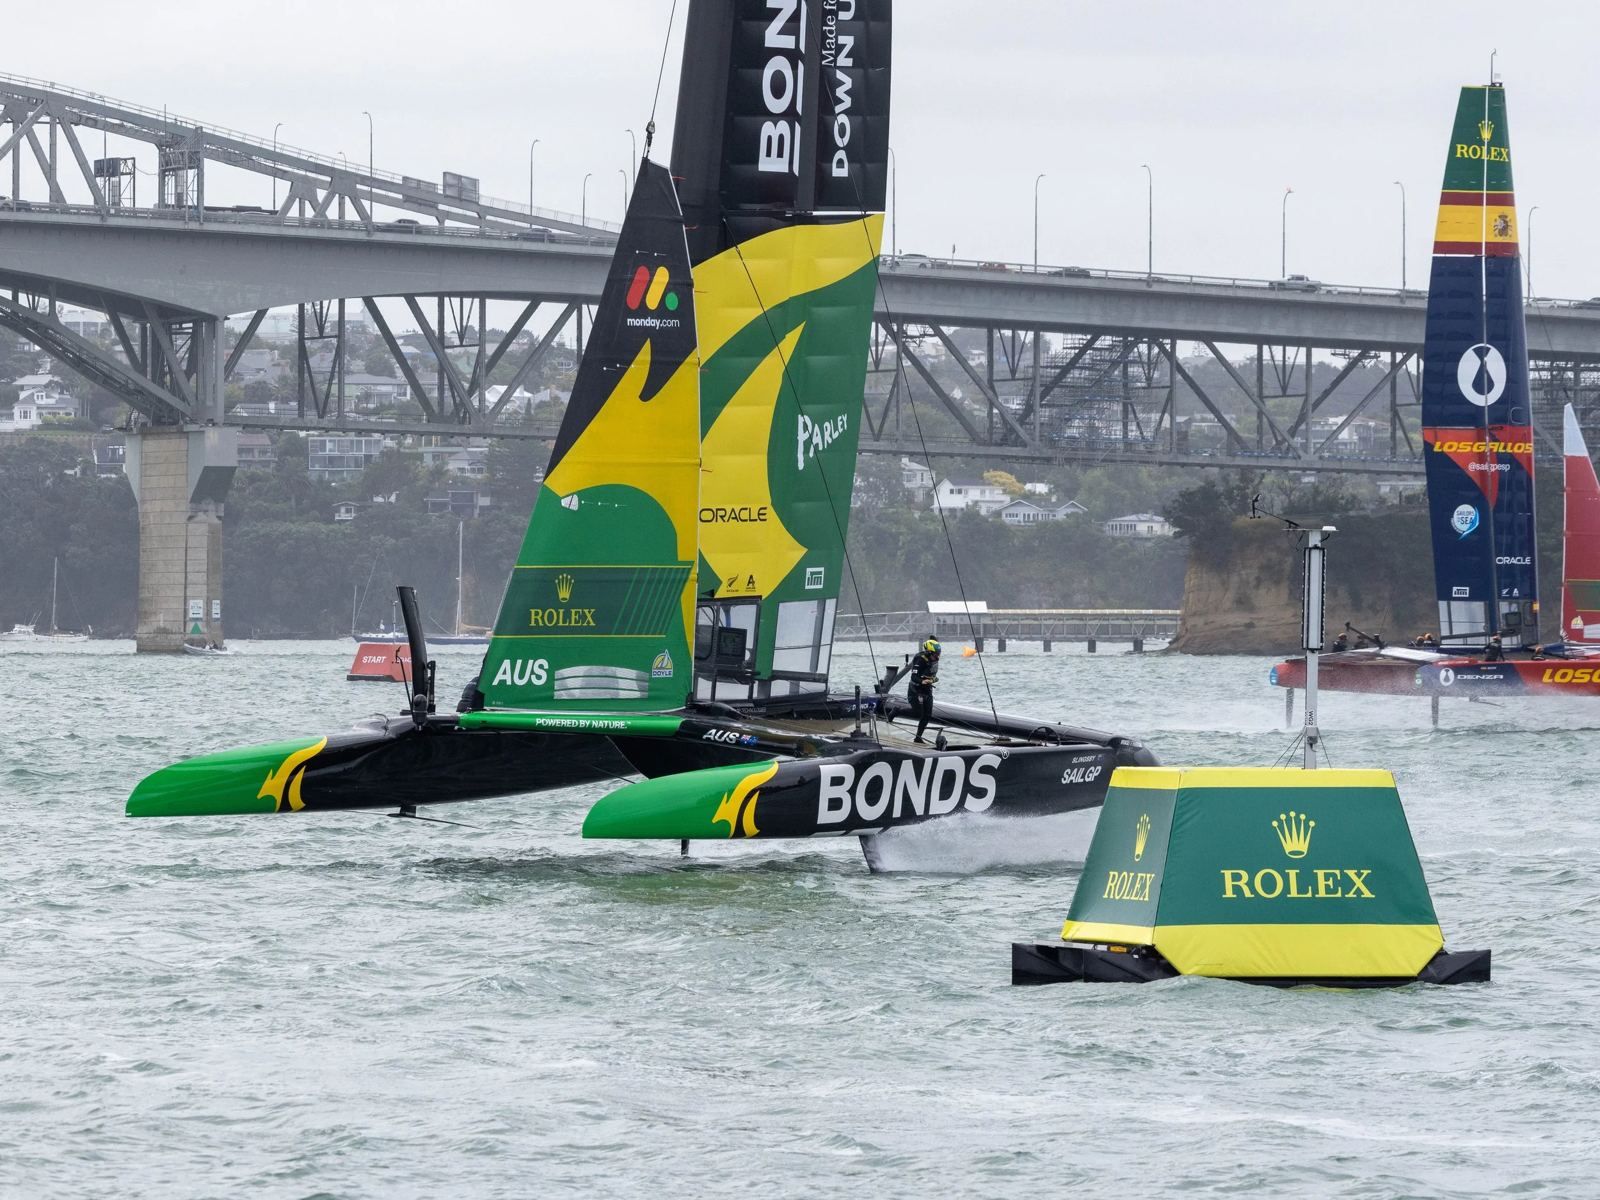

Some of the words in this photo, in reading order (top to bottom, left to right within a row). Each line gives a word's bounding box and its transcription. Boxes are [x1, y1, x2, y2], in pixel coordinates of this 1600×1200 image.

[822, 15, 836, 67] Made
[758, 0, 798, 173] BON
[832, 35, 855, 177] DOWN
[1455, 143, 1510, 162] ROLEX
[627, 316, 680, 330] monday.com
[797, 413, 848, 470] PARLEY
[699, 506, 768, 523] ORACLE
[1495, 556, 1531, 565] ORACLE
[528, 608, 596, 626] ROLEX
[362, 656, 387, 664] START
[492, 658, 549, 686] AUS
[535, 718, 578, 728] POWERED
[579, 719, 591, 728] BY
[702, 728, 740, 744] AUS
[1102, 871, 1156, 901] ROLEX
[1220, 868, 1376, 898] ROLEX
